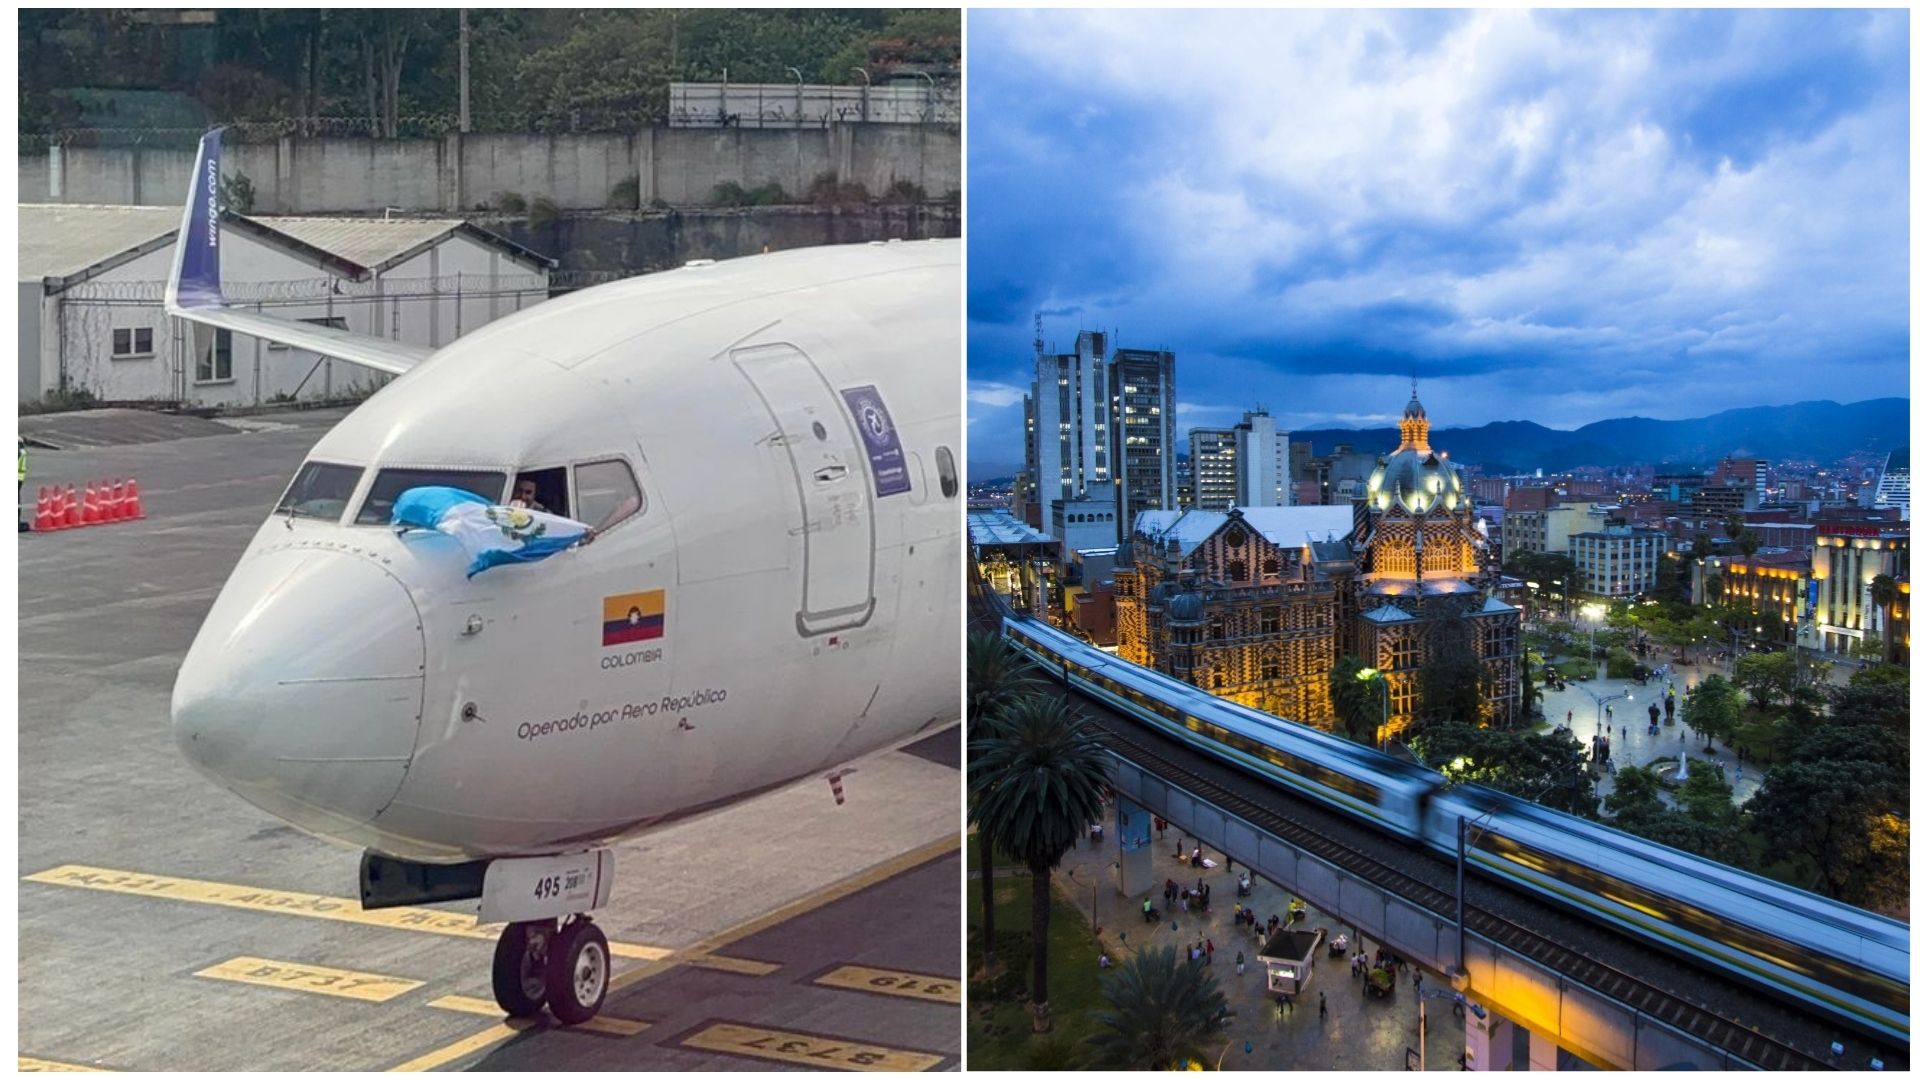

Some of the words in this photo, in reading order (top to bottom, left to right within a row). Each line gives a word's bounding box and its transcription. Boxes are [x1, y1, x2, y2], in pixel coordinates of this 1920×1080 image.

[207, 159, 217, 247] wingo.com
[600, 648, 662, 669] COLOMBIA
[517, 713, 589, 741] Operado
[590, 709, 619, 729] por
[620, 700, 657, 720] Aero
[534, 876, 560, 899] 495
[246, 966, 367, 989] B737
[740, 1036, 886, 1065] B737
